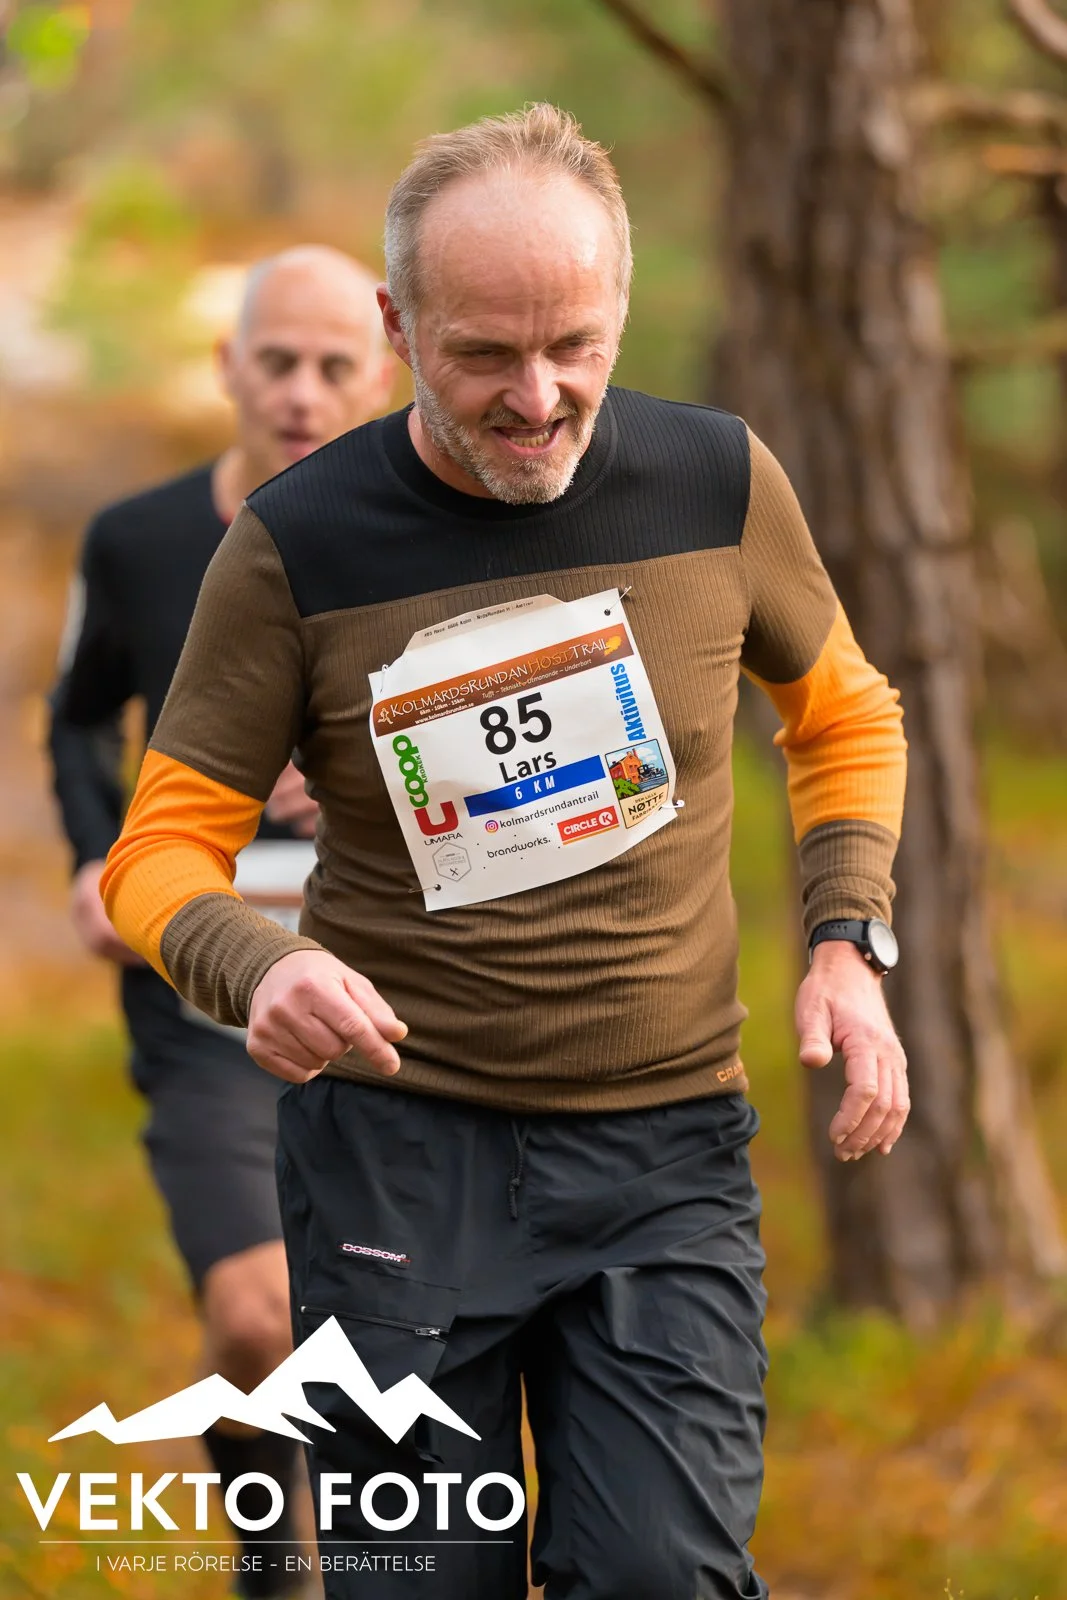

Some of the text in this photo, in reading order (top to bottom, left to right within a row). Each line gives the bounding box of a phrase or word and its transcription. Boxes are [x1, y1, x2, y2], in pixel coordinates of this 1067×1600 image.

[610, 663, 647, 741] Aktivitus
[480, 692, 552, 755] 85
[392, 734, 429, 808] coop
[499, 751, 557, 784] Lars
[500, 791, 599, 829] kolmardsrundantrail
[515, 787, 523, 800] 6
[424, 832, 463, 846] UMARA
[563, 818, 599, 835] CIRCLE
